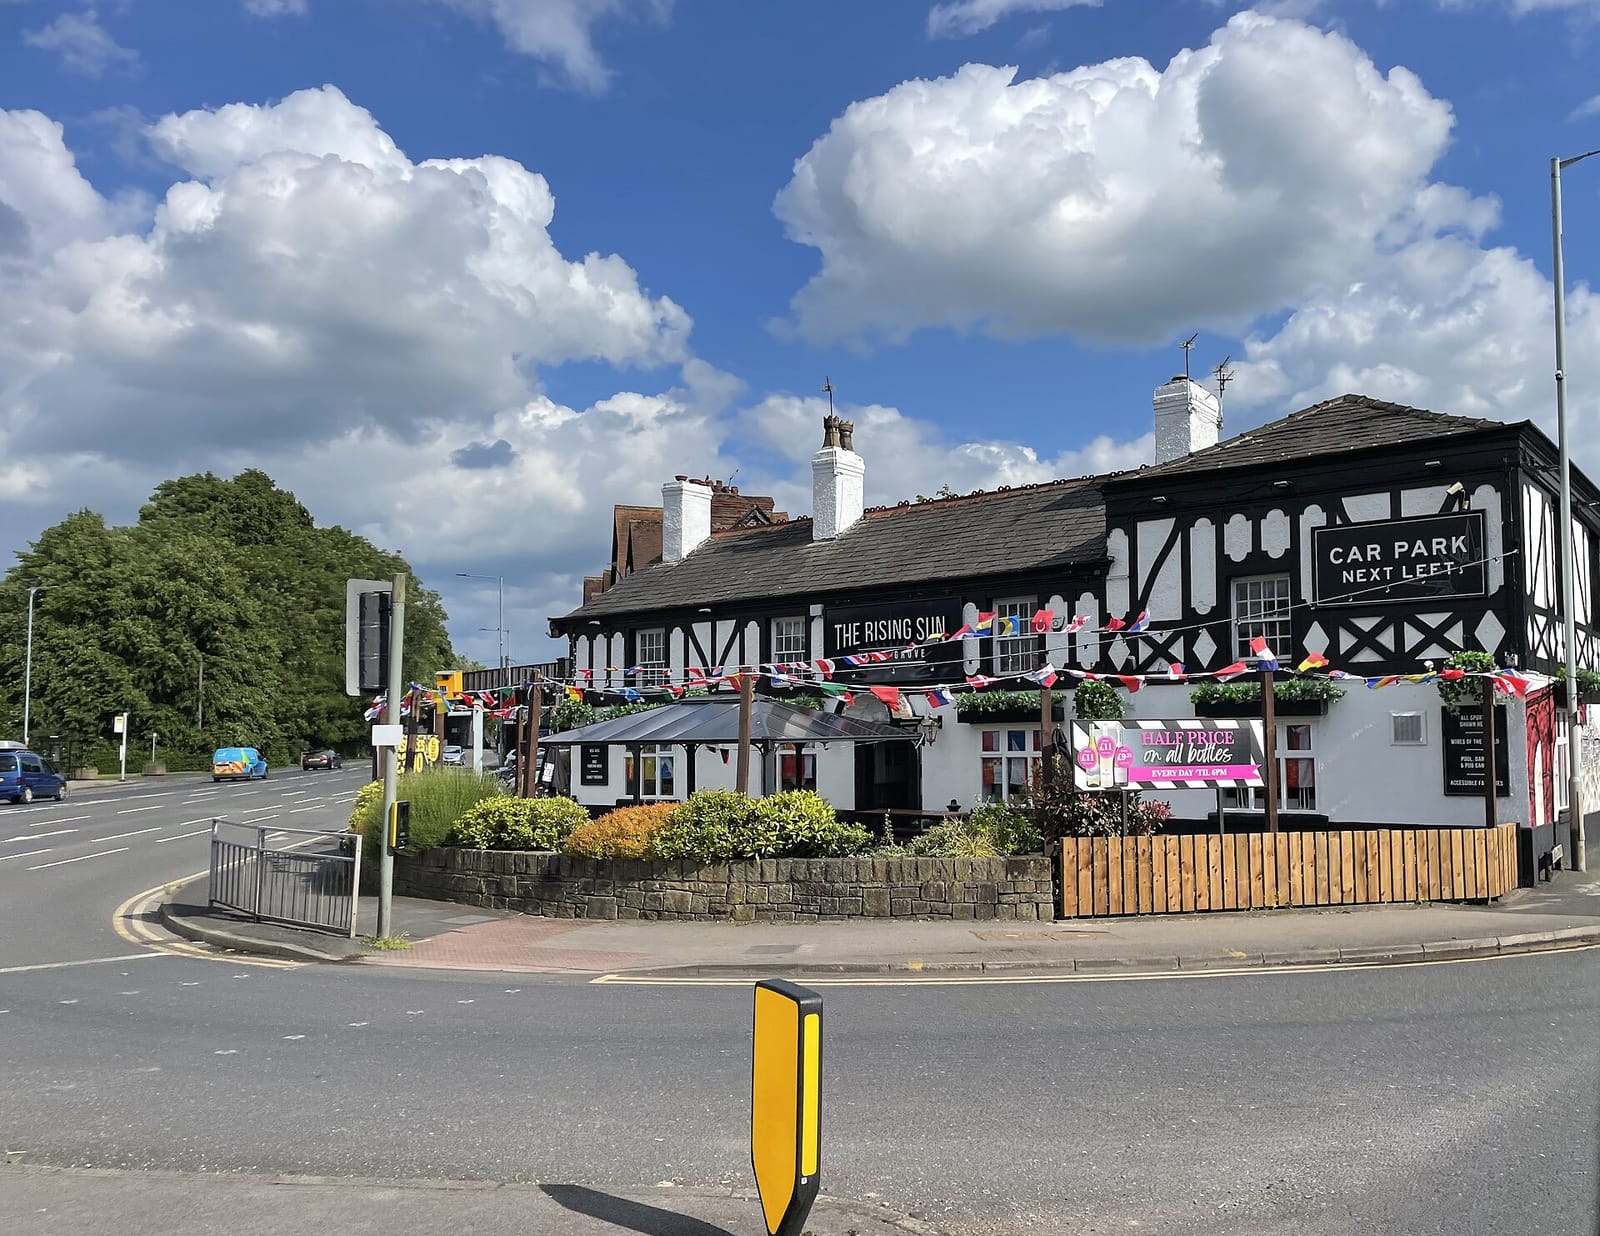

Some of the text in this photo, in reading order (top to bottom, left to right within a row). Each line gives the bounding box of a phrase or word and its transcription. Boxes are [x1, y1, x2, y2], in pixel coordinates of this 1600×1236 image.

[1330, 536, 1467, 564] CAR PARK
[1342, 562, 1454, 583] NEXT LEFT
[834, 615, 945, 649] THE RISING SUN
[1142, 730, 1235, 746] HALF PRICE
[1143, 743, 1233, 763] on all bottles
[1152, 769, 1178, 777] EVERY
[1179, 769, 1194, 777] DAY
[1211, 768, 1227, 776] 6PM
